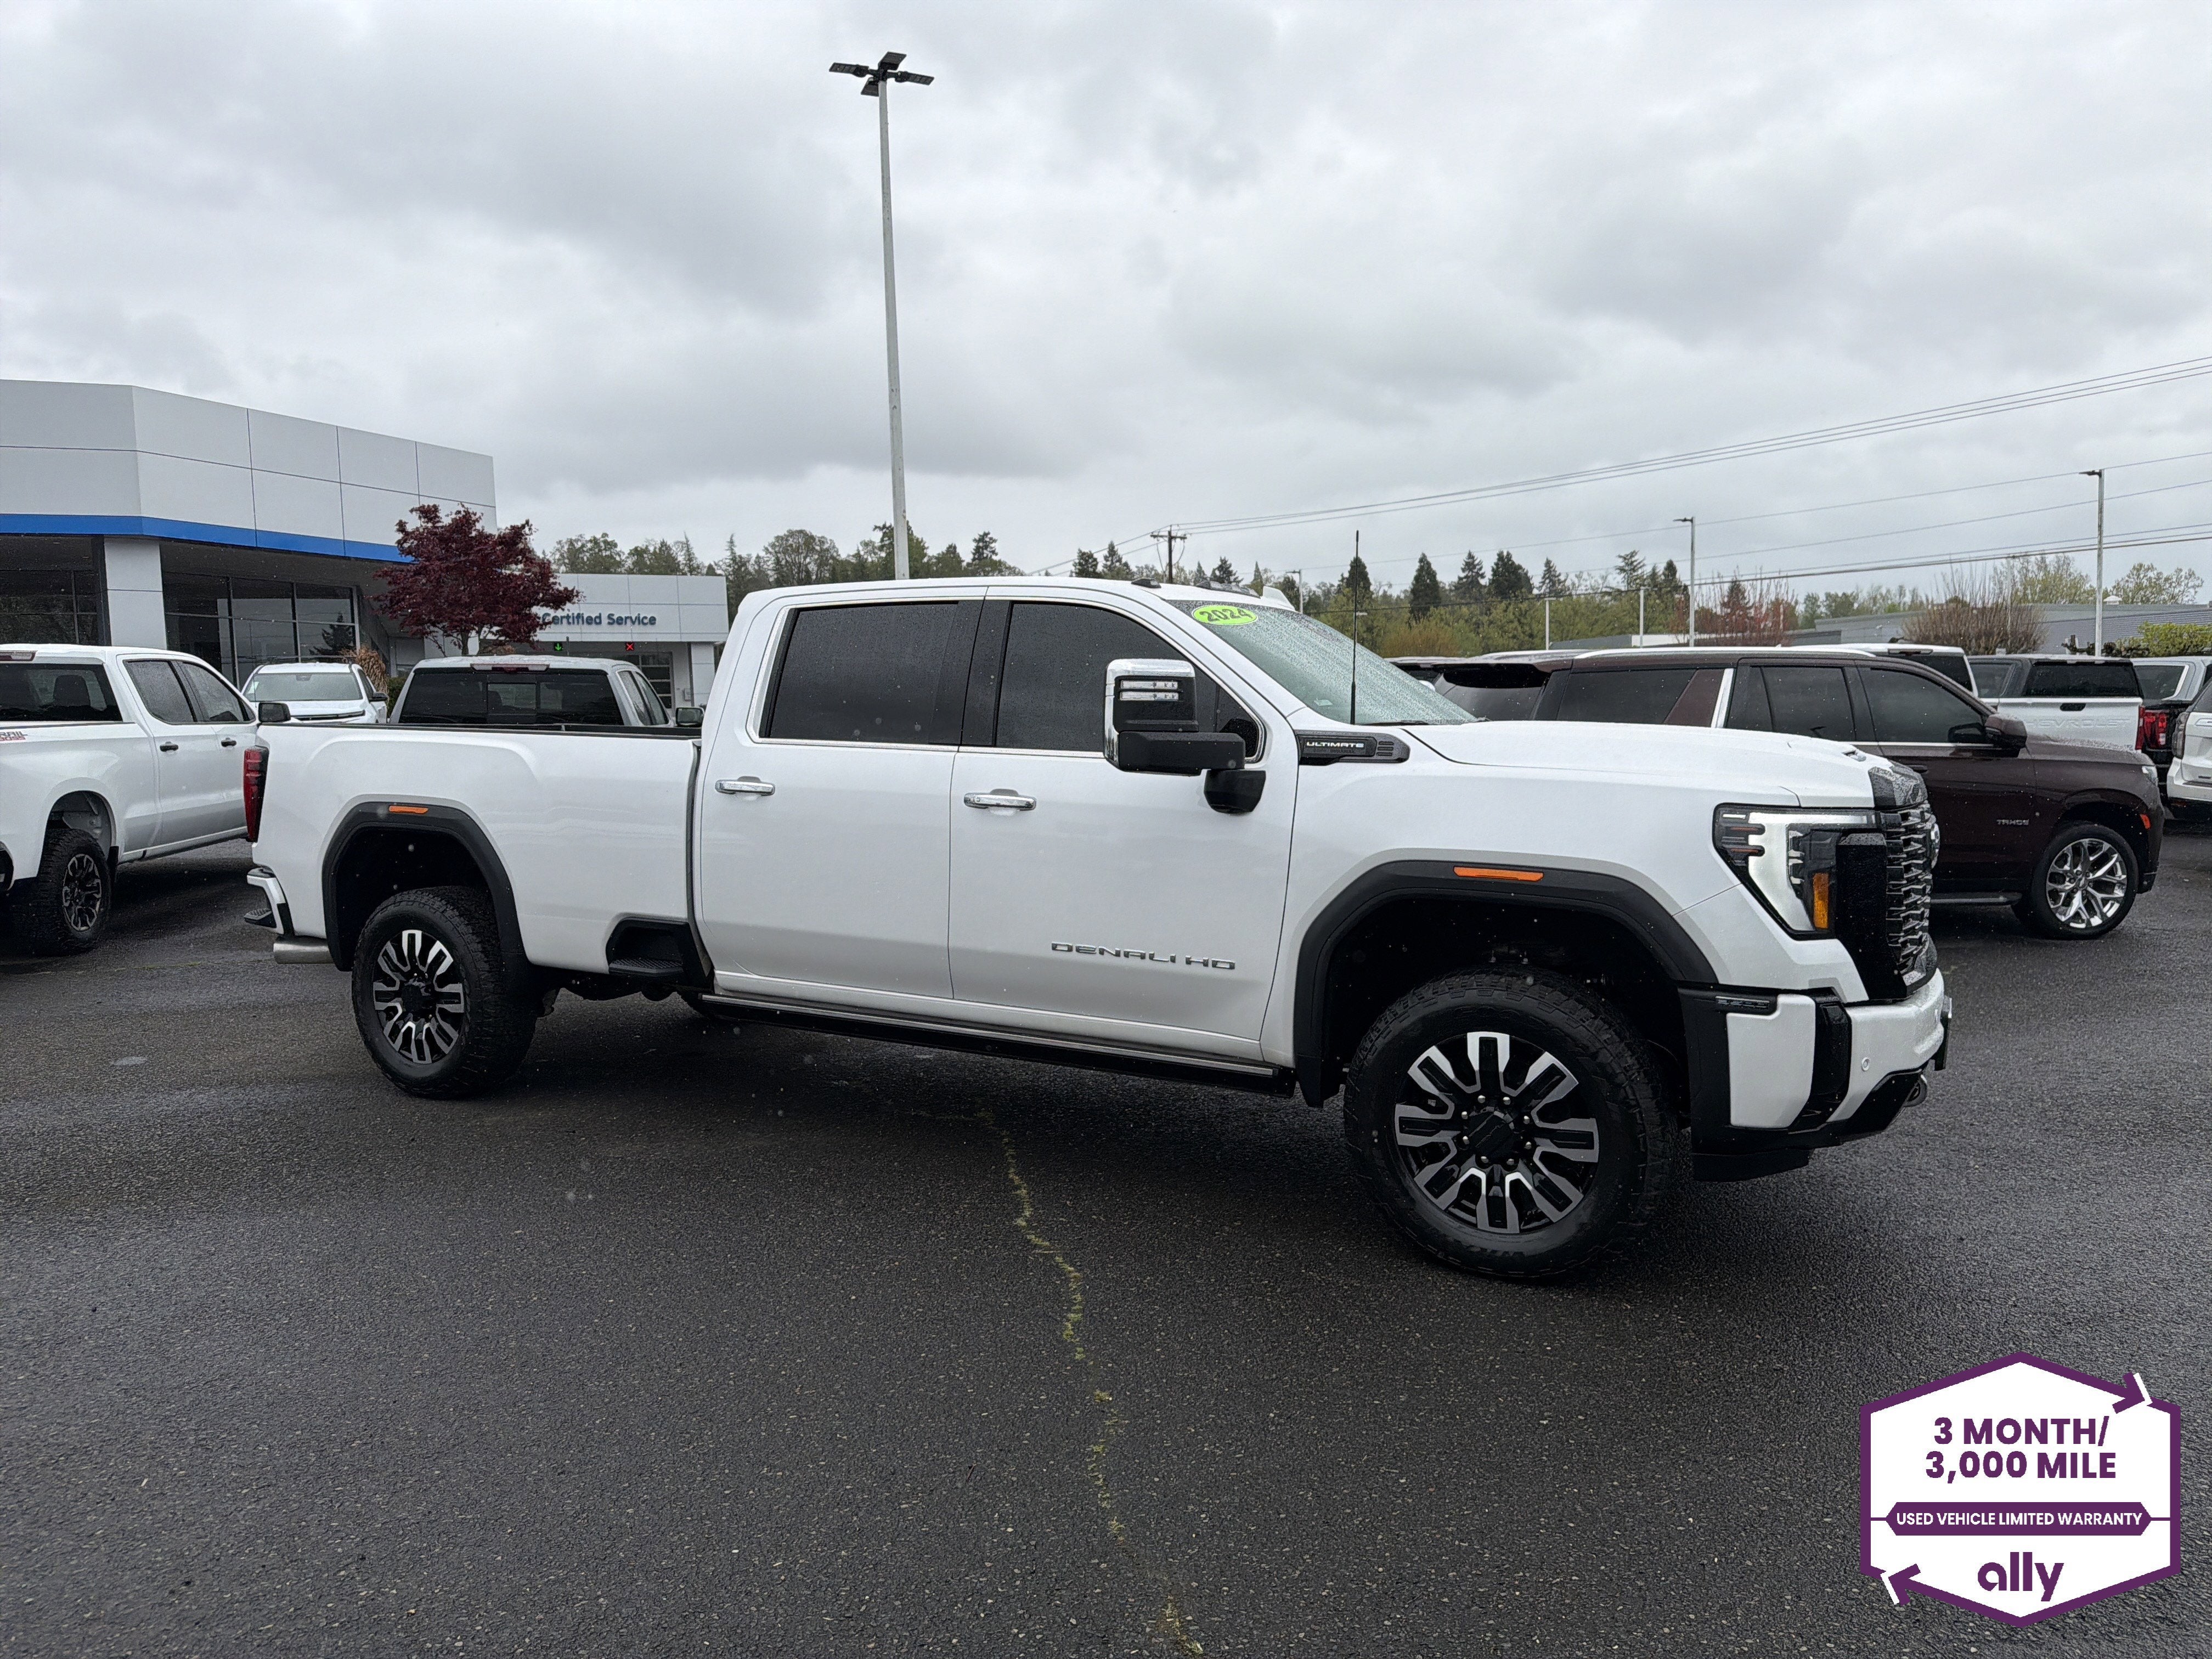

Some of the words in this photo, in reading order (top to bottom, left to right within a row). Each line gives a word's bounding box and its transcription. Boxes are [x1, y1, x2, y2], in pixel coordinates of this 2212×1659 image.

[542, 612, 602, 625] Certified
[607, 612, 657, 625] Service
[1199, 608, 1253, 622] 2024
[2024, 719, 2131, 728] HEVROLET
[1051, 941, 1176, 963] DENALI
[1185, 955, 1235, 970] HD
